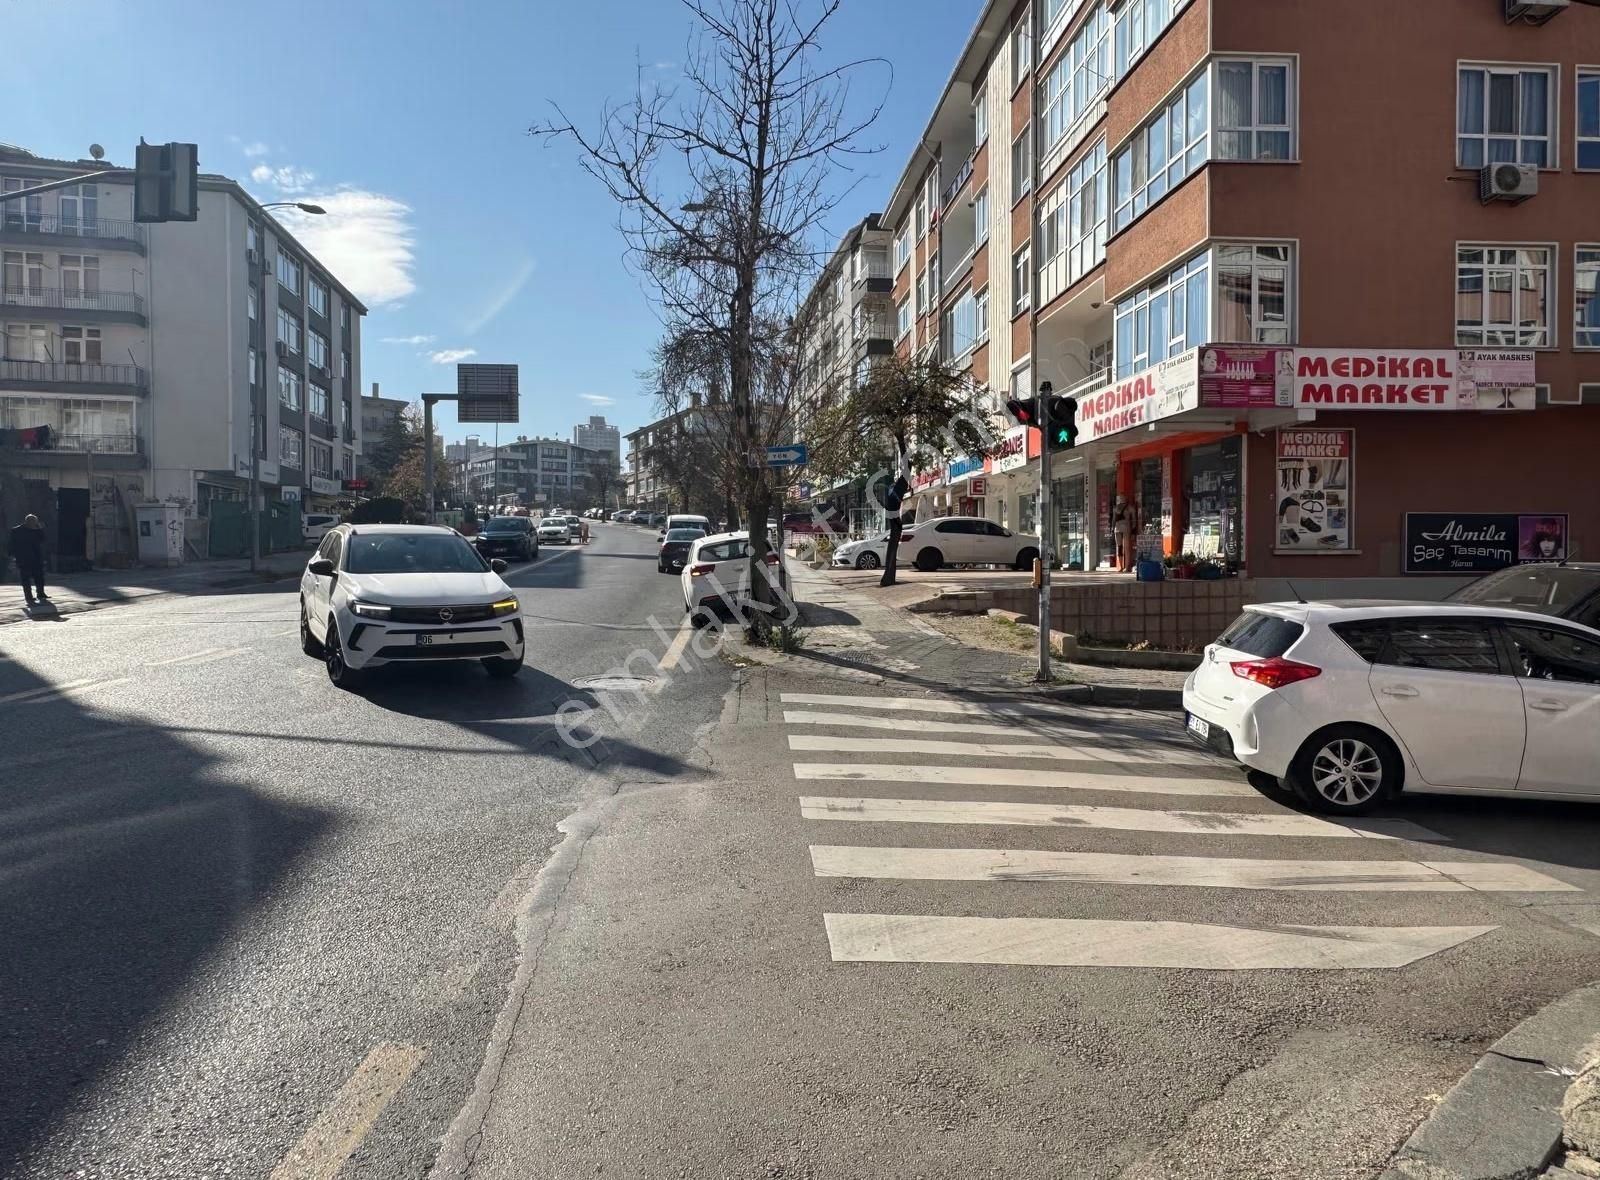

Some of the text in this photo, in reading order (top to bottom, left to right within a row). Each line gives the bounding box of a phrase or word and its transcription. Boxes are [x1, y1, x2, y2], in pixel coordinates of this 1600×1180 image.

[1301, 383, 1449, 404] MARKET
[1093, 405, 1144, 436] MARKET
[1284, 445, 1343, 456] MARKET
[973, 480, 983, 492] E
[1421, 520, 1506, 541] Almila
[1413, 545, 1512, 563] Saç Tasarım
[422, 635, 433, 644] 06
